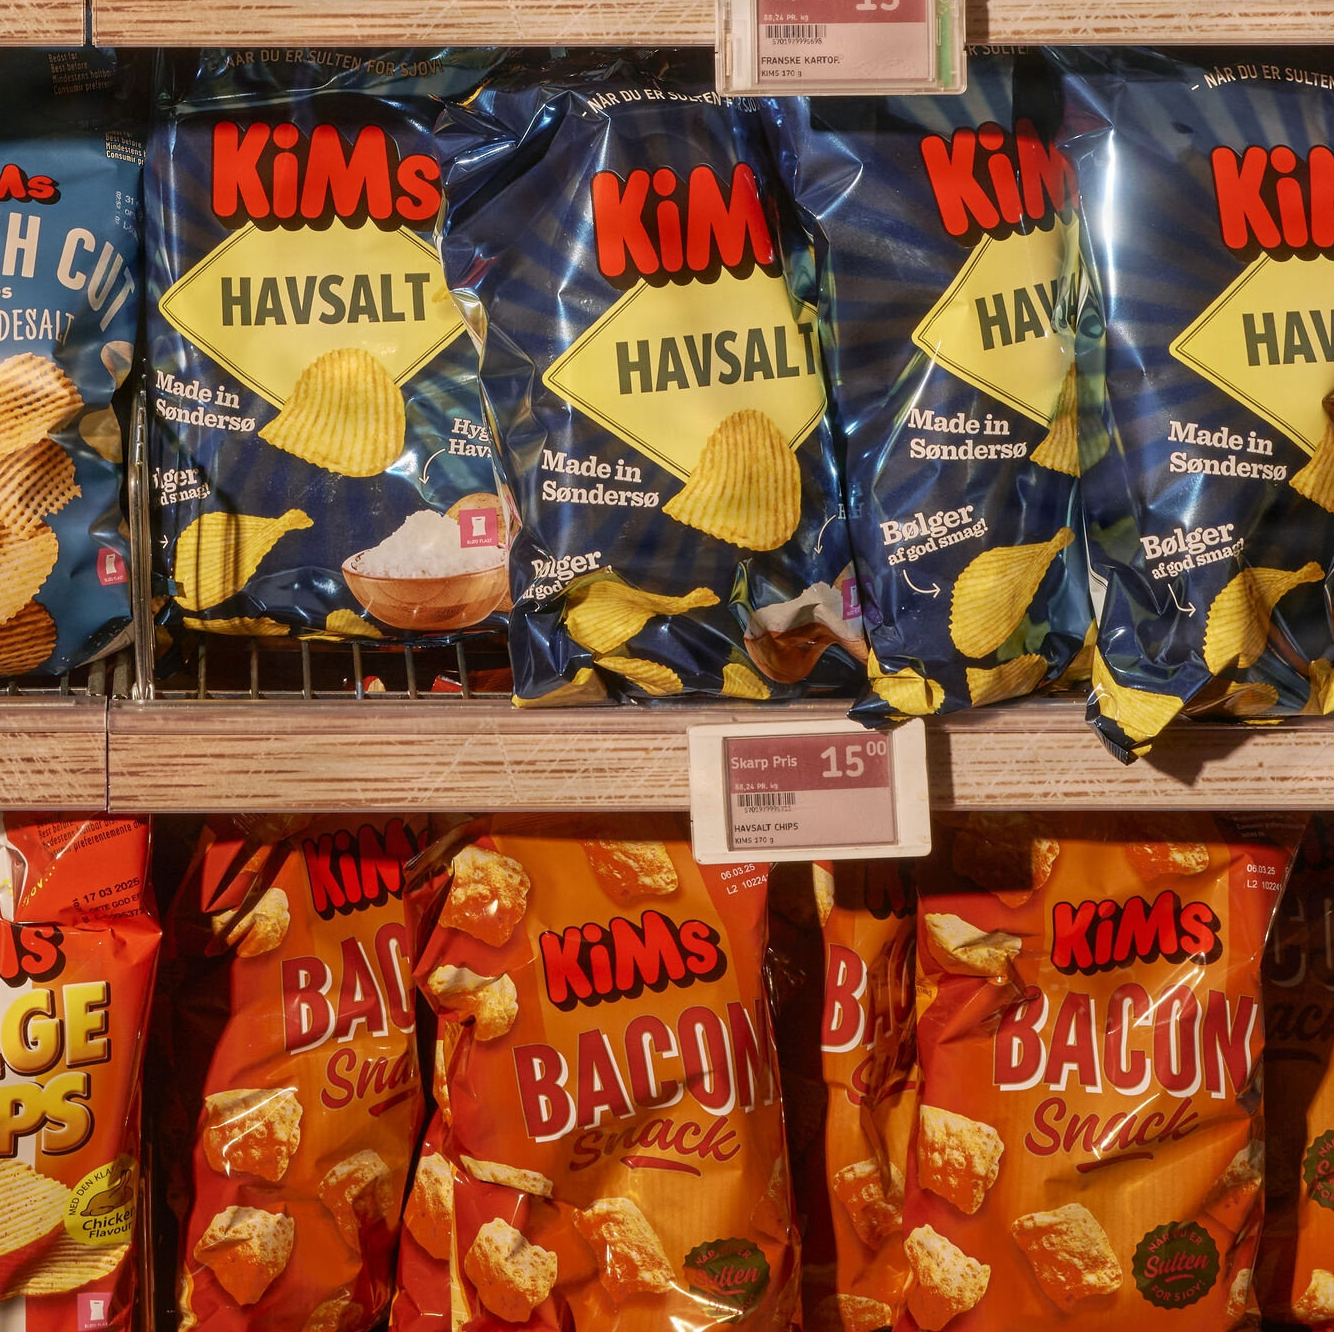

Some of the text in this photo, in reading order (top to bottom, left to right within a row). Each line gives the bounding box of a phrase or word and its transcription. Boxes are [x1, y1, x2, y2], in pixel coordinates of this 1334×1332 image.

[761, 56, 801, 65] FRANSKE
[212, 122, 441, 231] KiMs
[57, 228, 135, 331] CUT
[221, 273, 430, 326] HAVSALT
[616, 321, 817, 394] HAVSALT
[908, 408, 1010, 435] Made in
[1168, 421, 1274, 455] Made in
[910, 438, 1027, 460] Søndersø
[1169, 452, 1287, 481] Søndersø
[542, 482, 659, 507] Søndersø
[731, 741, 886, 778] Skarp Pris 15 00
[734, 823, 798, 832] HAVSALT CHIPS
[720, 862, 756, 881] 06.03.25
[1051, 890, 1223, 976] KiMs
[539, 910, 727, 1012] KiMs
[993, 984, 1259, 1100] BACON
[1025, 1097, 1200, 1157] Snack
